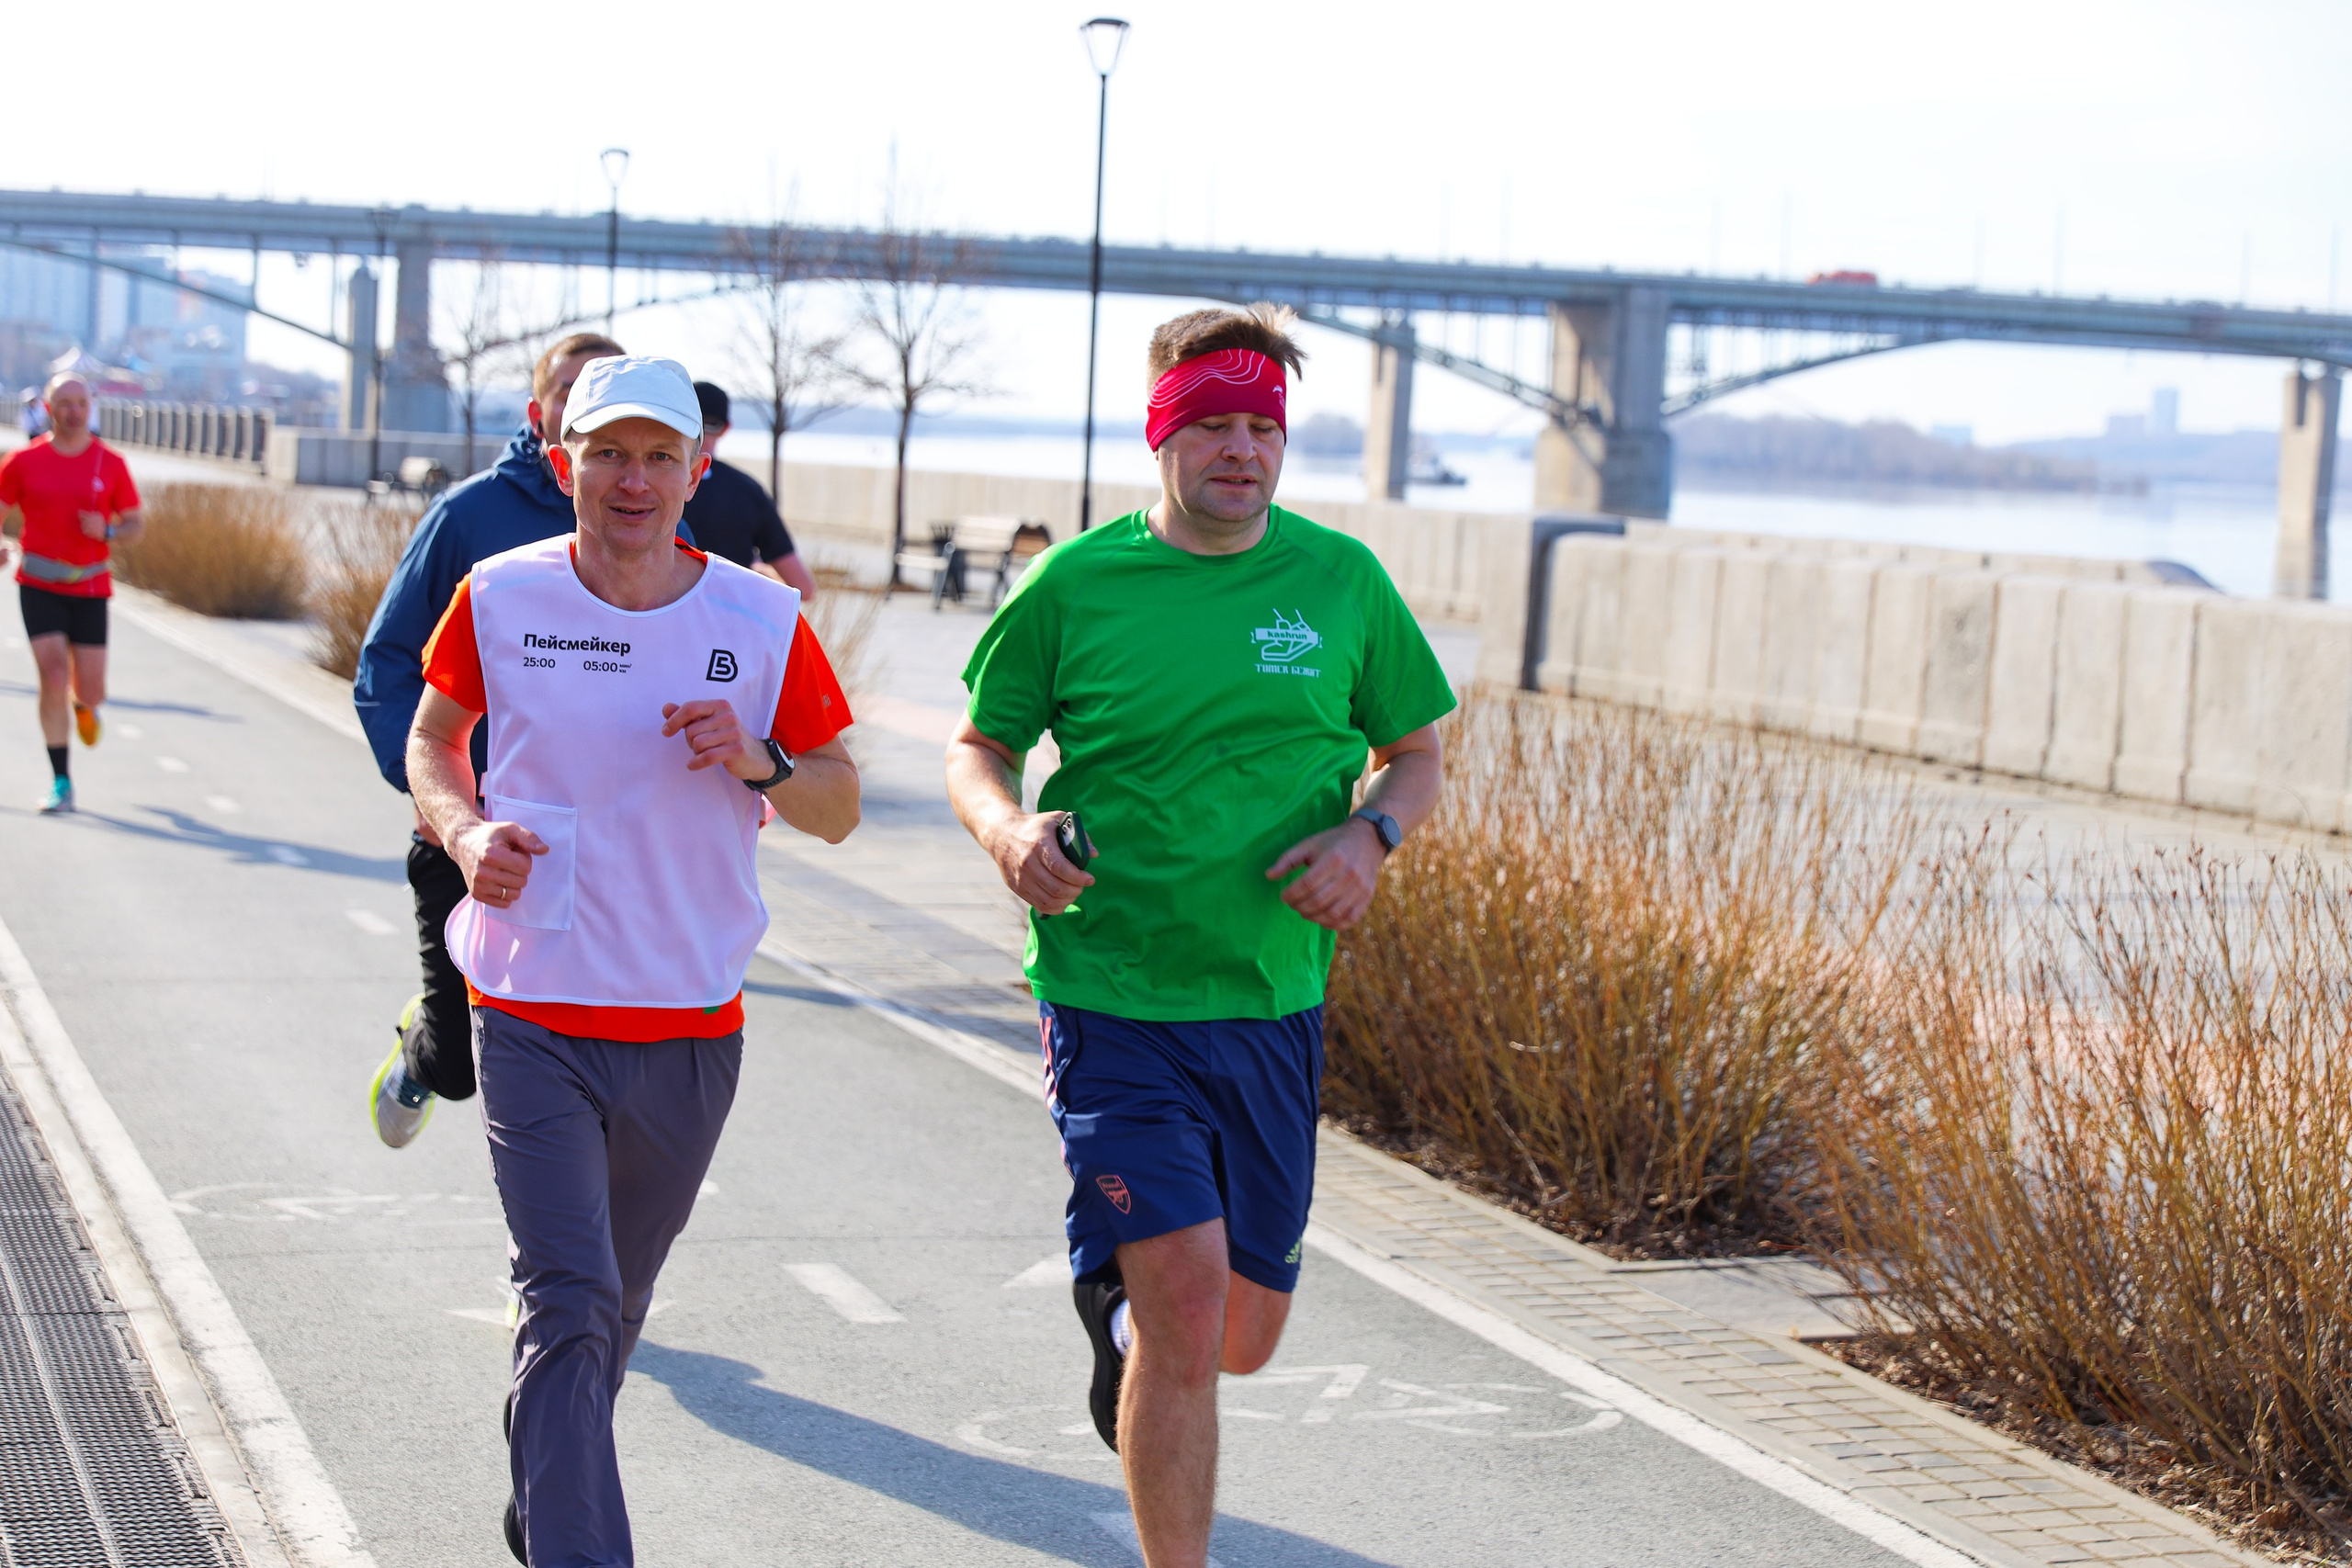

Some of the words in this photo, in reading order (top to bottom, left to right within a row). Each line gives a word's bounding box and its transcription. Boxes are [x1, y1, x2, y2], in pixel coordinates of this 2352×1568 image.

[1267, 630, 1308, 640] kashrun
[524, 633, 631, 657] Пейсмейкер
[523, 657, 556, 669] 25:00
[583, 660, 618, 672] 05:00
